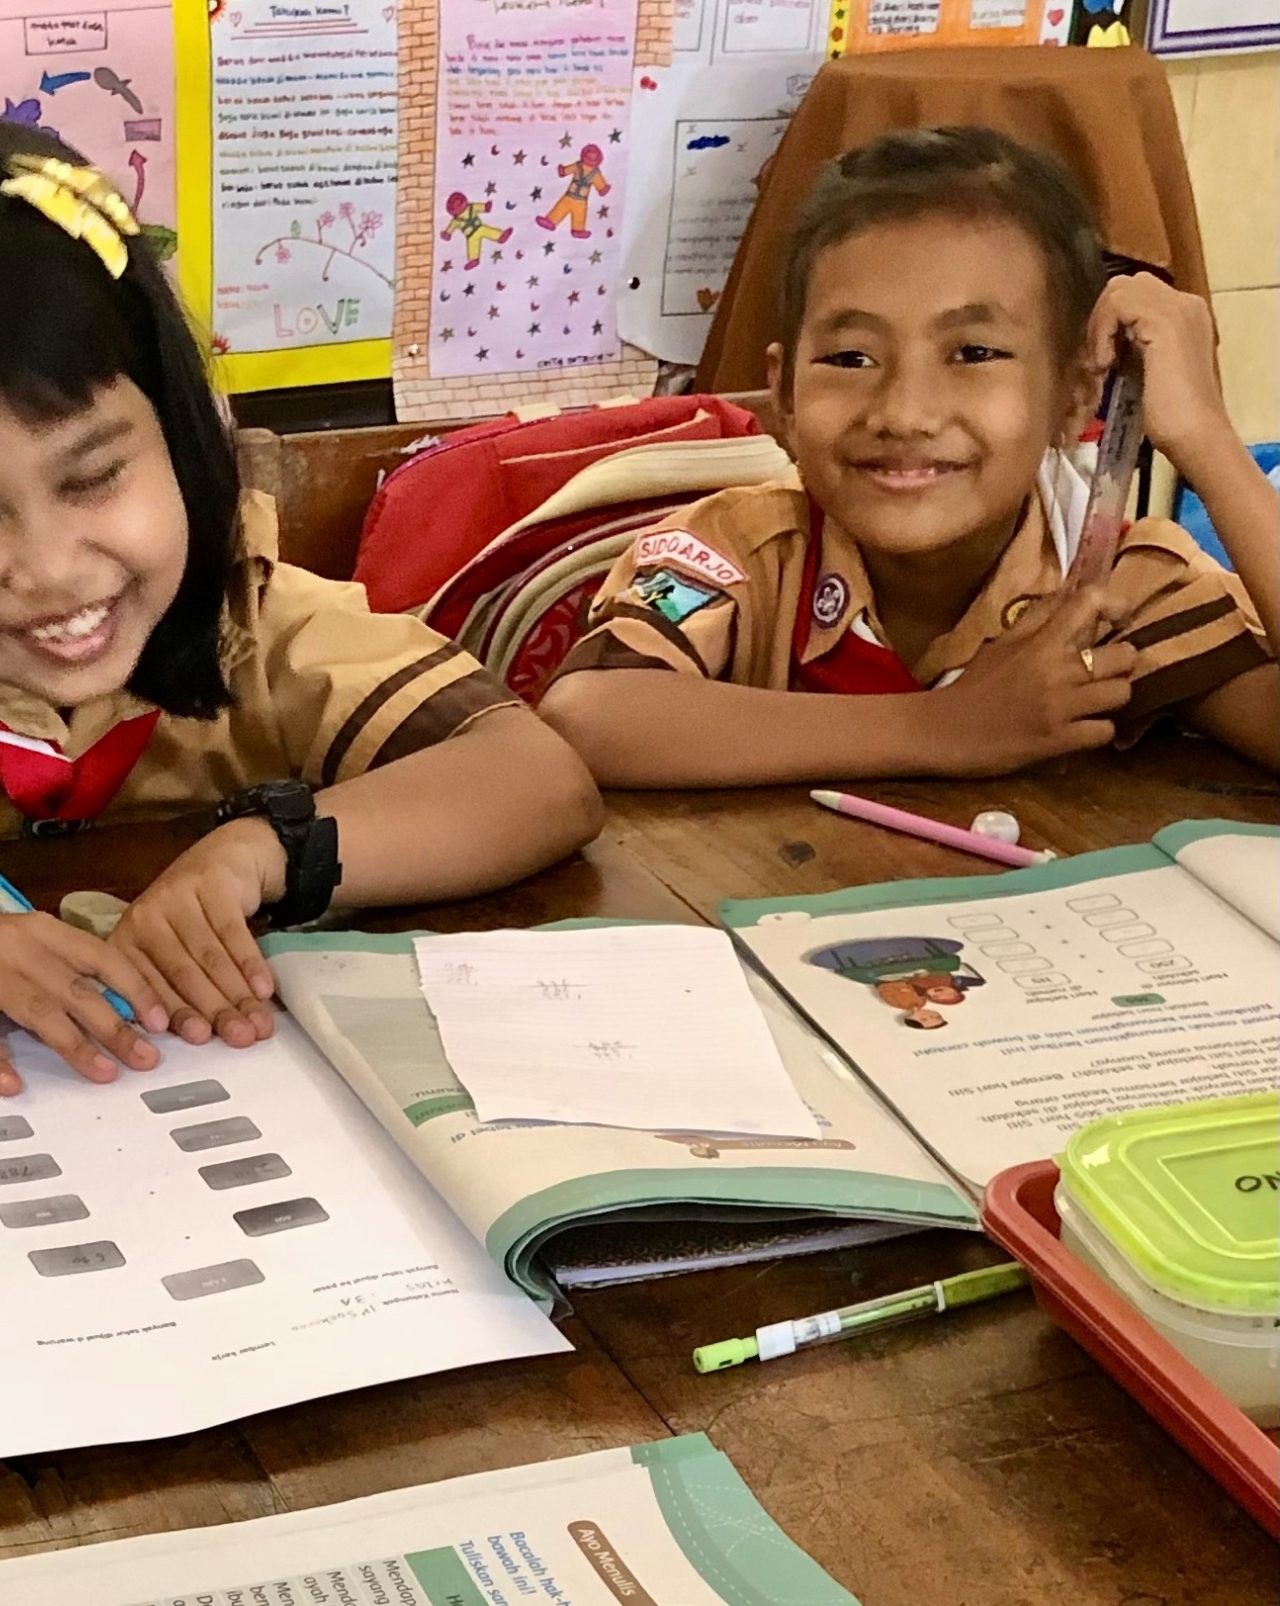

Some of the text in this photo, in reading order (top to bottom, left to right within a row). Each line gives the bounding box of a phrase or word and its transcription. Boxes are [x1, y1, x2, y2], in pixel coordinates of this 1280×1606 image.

[273, 298, 361, 338] LOVE
[640, 536, 734, 580] SIDOARJO
[459, 1540, 494, 1588] Tuliskan
[487, 1536, 520, 1575] bawah
[510, 1531, 546, 1578] Bacalah
[578, 1527, 638, 1598] Ayo Menulis
[303, 1575, 331, 1604] ayah
